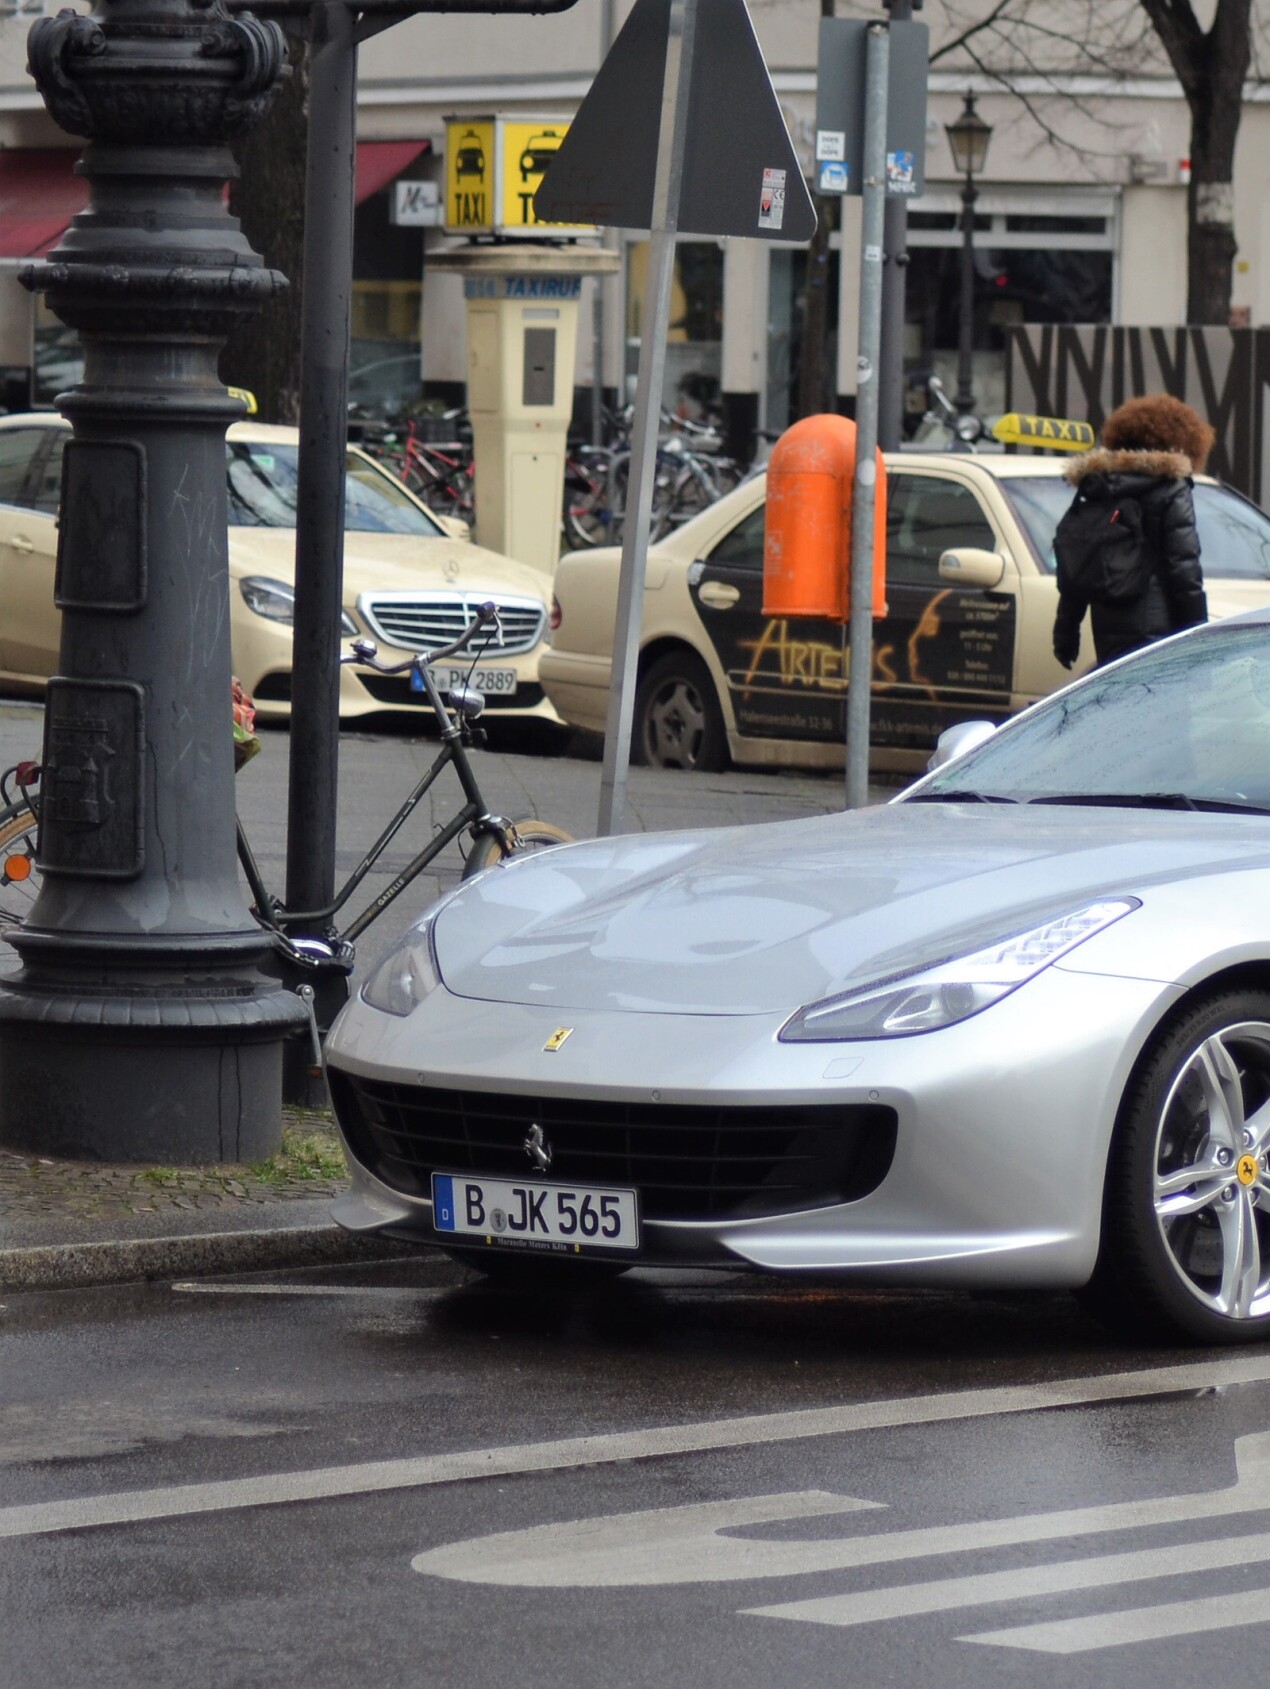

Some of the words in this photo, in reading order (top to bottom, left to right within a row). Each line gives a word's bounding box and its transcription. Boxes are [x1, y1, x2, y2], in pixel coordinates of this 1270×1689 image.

[455, 193, 485, 225] TAXI
[505, 277, 582, 297] TAXIRUF
[1026, 417, 1083, 441] TAXI
[737, 618, 897, 700] ARTES
[449, 671, 471, 688] PK
[476, 672, 514, 691] 2889
[378, 878, 406, 906] GAZELLE
[441, 1208, 450, 1221] D
[465, 1184, 485, 1227] B
[507, 1190, 550, 1234] JK
[557, 1192, 621, 1238] 565
